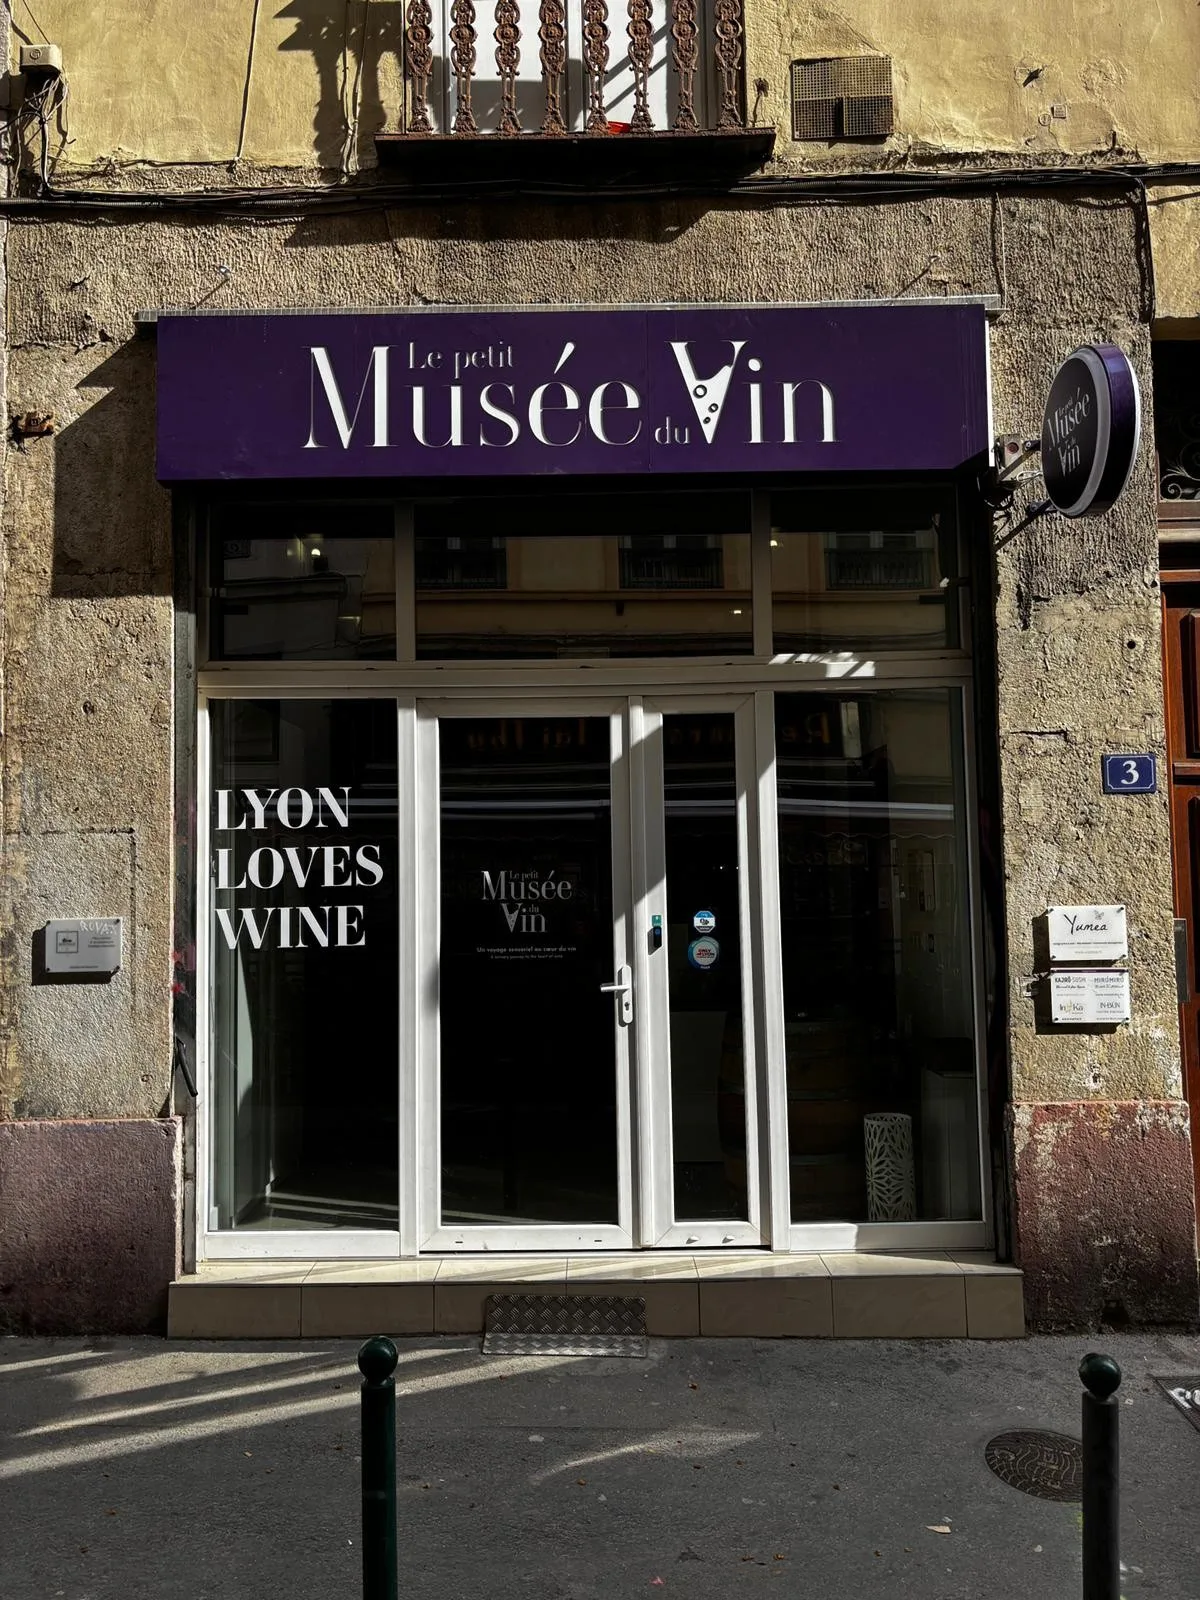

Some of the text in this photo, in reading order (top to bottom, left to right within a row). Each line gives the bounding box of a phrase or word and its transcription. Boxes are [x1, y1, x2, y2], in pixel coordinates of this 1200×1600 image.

[408, 341, 513, 379] Le petit
[302, 340, 842, 449] Musée du Vin
[1046, 386, 1090, 452] Musée
[1058, 443, 1080, 477] Vin
[1121, 760, 1139, 785] 3
[215, 787, 352, 831] LYON
[215, 845, 384, 890] LOVES
[481, 870, 572, 900] Musée
[214, 905, 366, 950] WINE
[500, 902, 547, 933] Vin
[1063, 914, 1108, 935] Yumea
